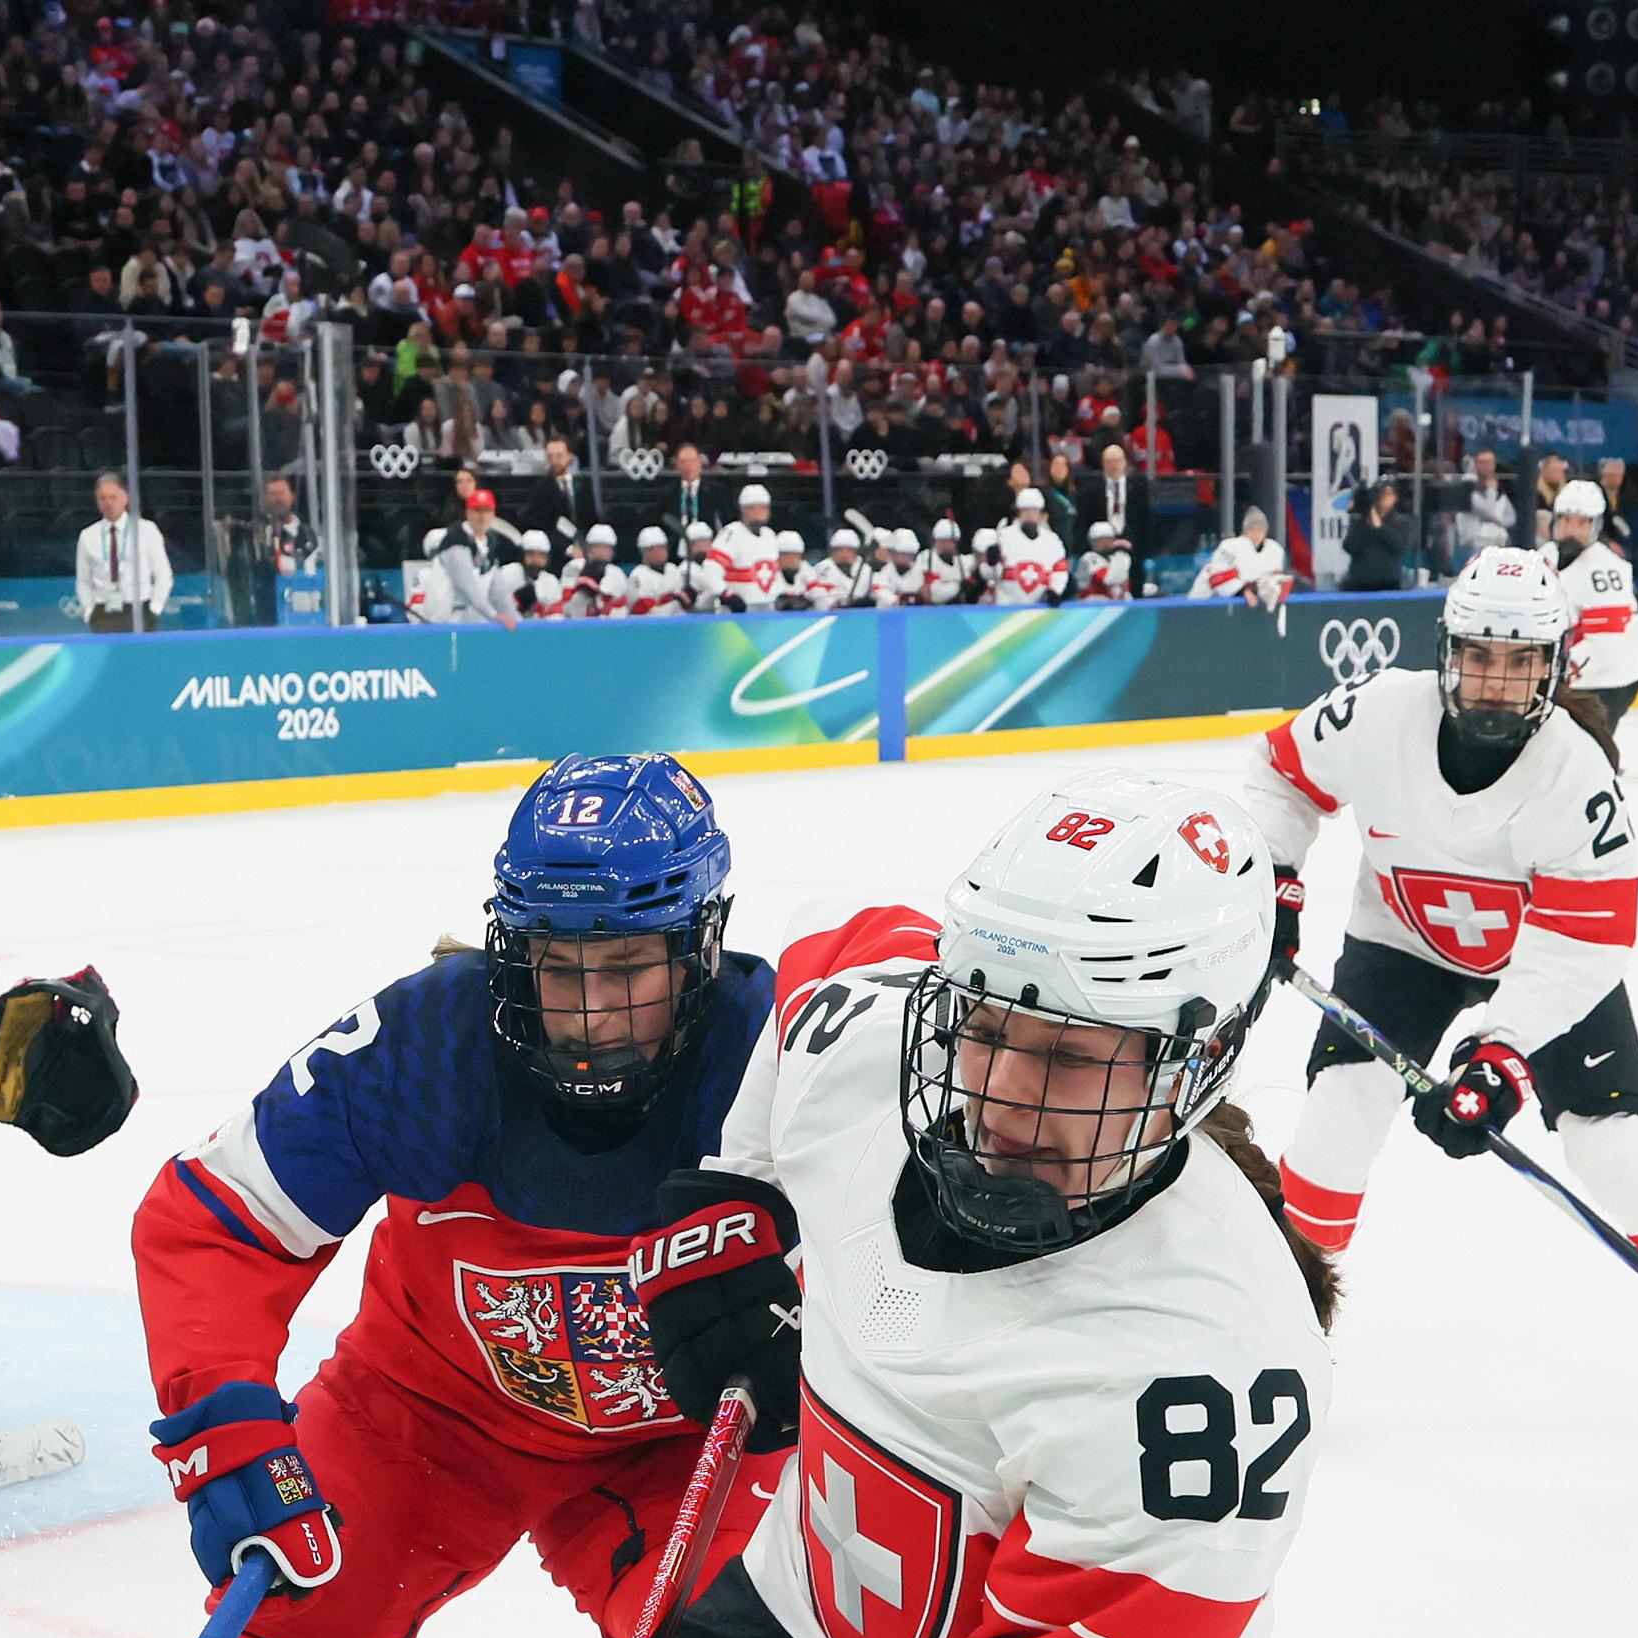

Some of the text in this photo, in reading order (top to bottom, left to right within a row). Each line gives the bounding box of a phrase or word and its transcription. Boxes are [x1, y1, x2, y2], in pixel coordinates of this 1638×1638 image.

[1497, 563, 1523, 577] 22
[1591, 569, 1624, 593] 68
[170, 667, 438, 711] MILANO CORTINA
[277, 706, 341, 741] 2026
[556, 796, 604, 824] 12
[1586, 778, 1636, 859] 2
[1046, 811, 1115, 852] 82
[537, 882, 605, 892] MILANO CORTINA
[561, 890, 578, 898] 2026
[969, 928, 1050, 955] MILANO CORTINA
[997, 943, 1016, 956] 2026
[628, 1211, 757, 1291] UER
[1136, 1368, 1312, 1523] 82
[298, 1521, 316, 1567] CCM
